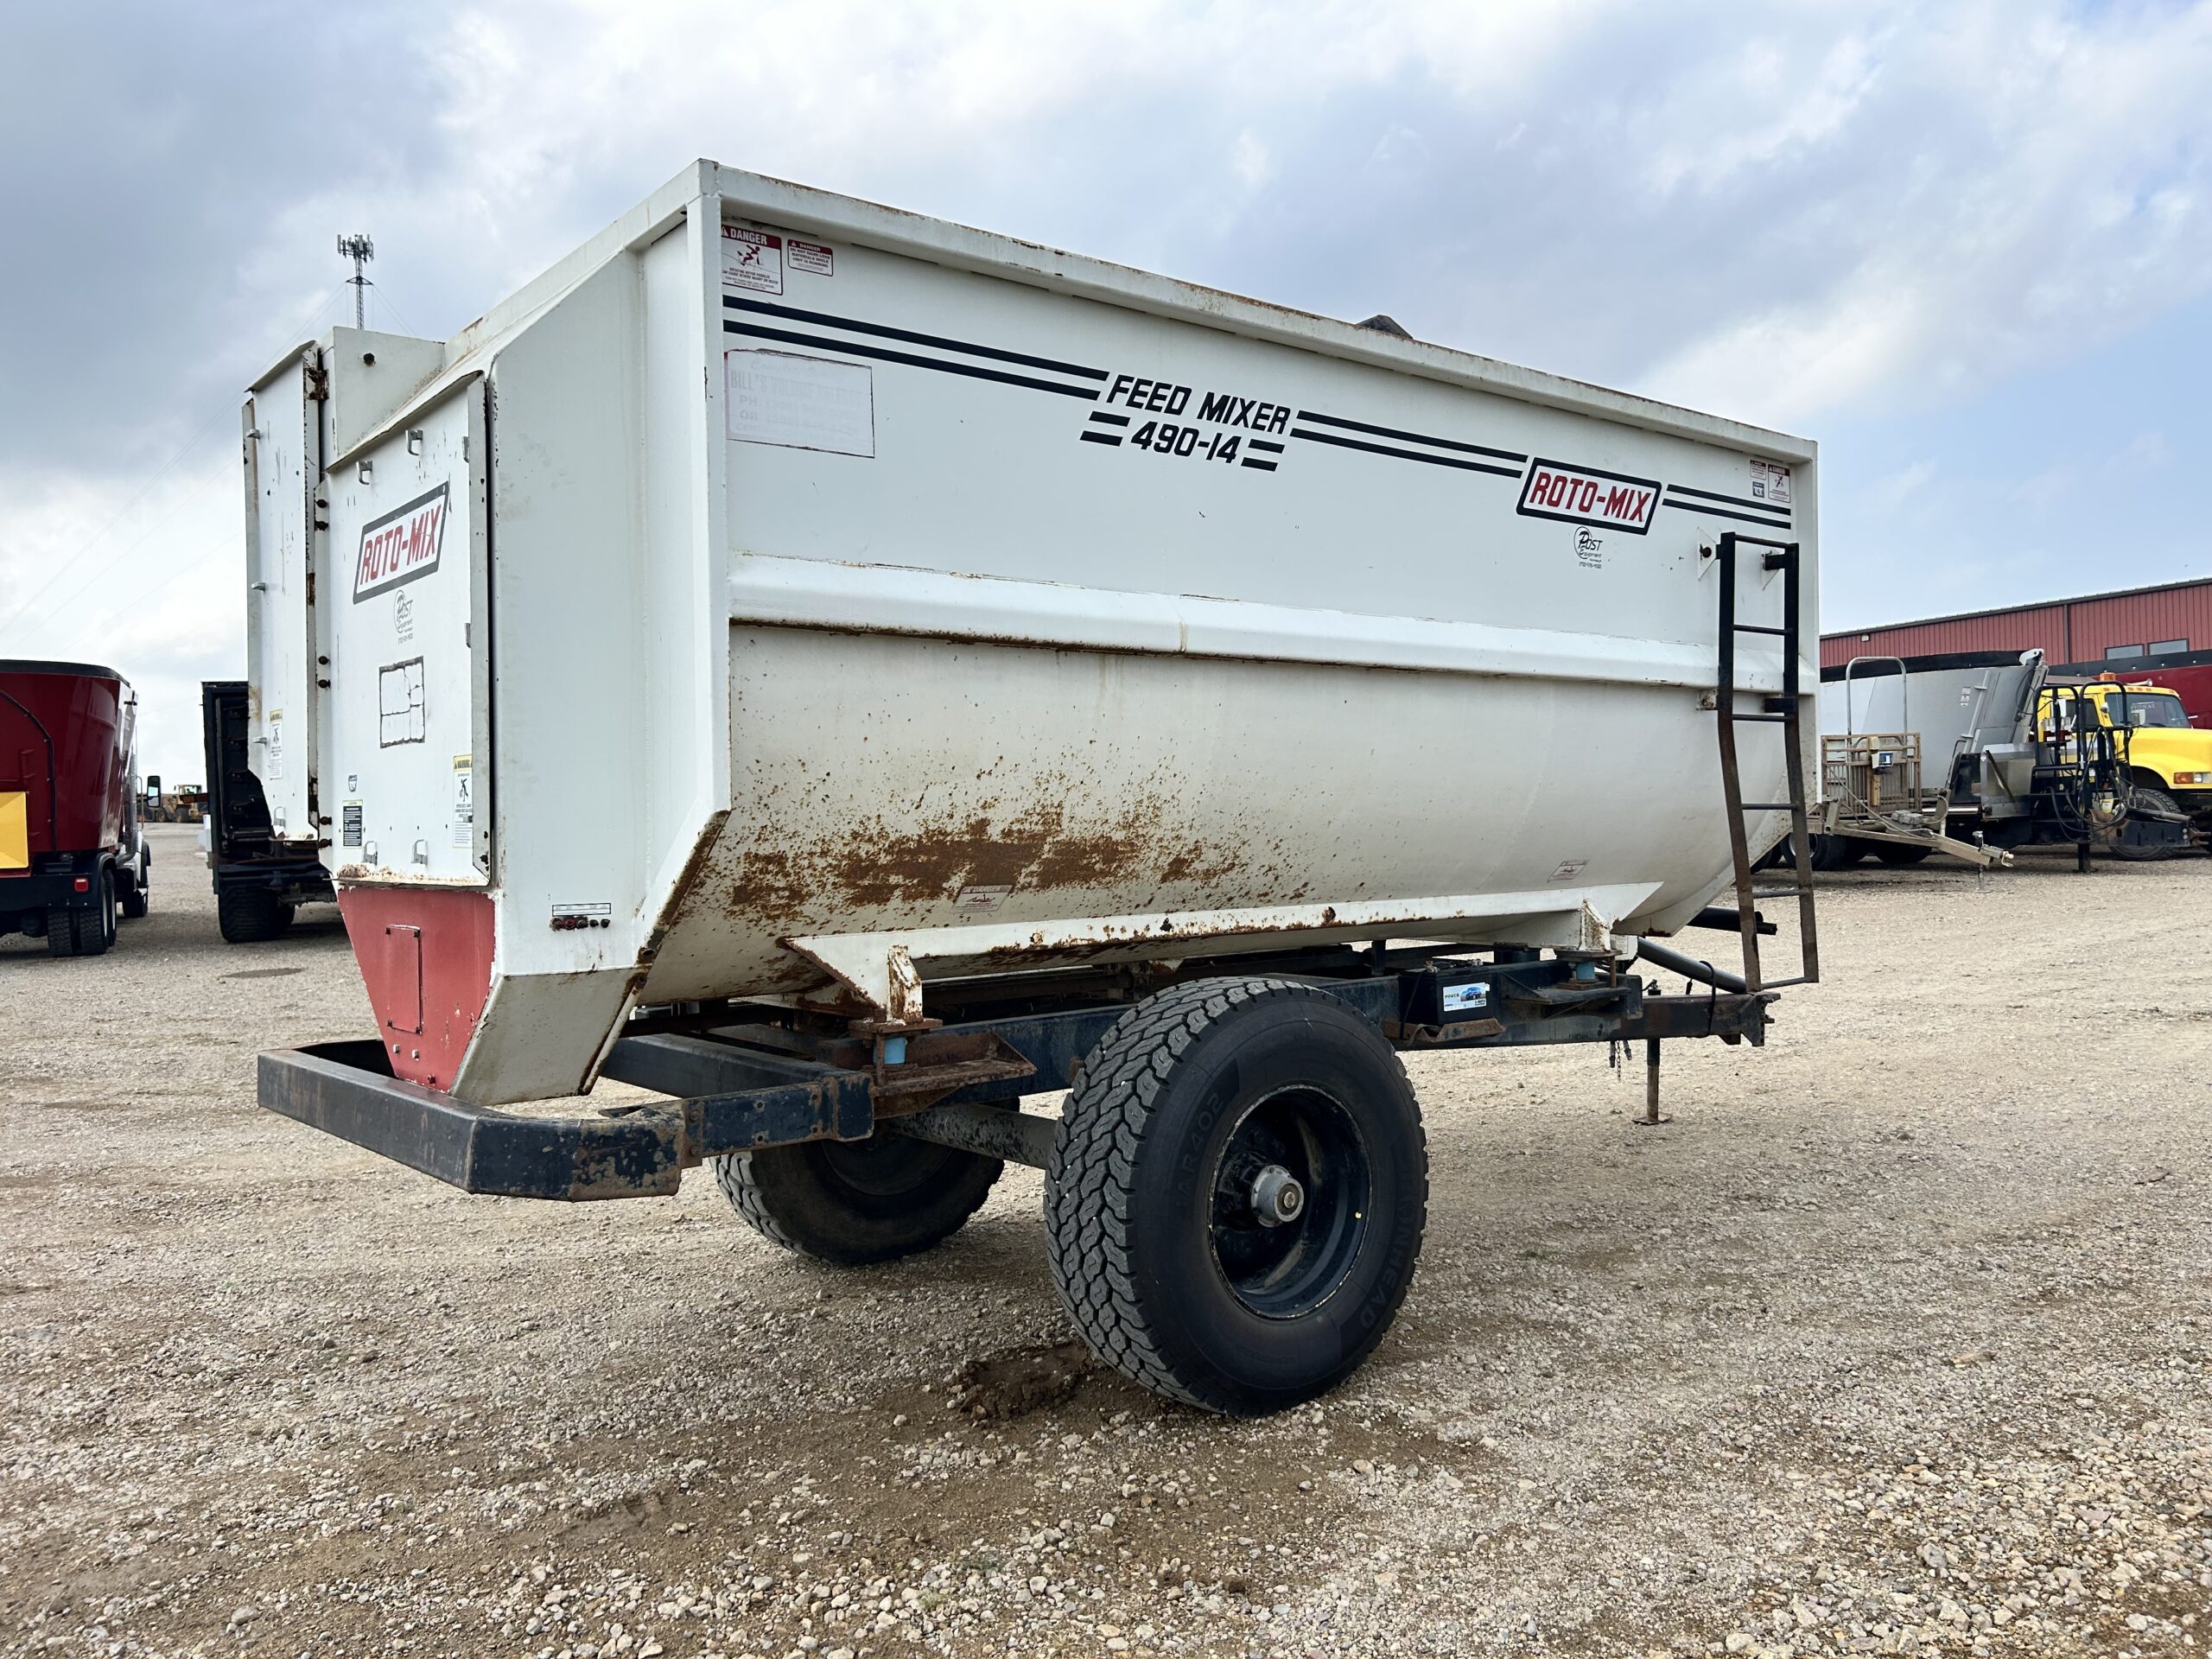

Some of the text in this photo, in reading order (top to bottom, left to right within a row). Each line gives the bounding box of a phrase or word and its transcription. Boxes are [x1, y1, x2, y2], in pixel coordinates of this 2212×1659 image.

[730, 228, 767, 245] DANGER
[799, 243, 821, 252] DANGER
[739, 410, 759, 422] OR
[1106, 374, 1291, 435] FEED MIXER
[1130, 421, 1242, 464] 490-14
[1529, 472, 1651, 522] ROTO-MIX
[359, 504, 442, 585] ROTO-MIX
[1176, 1093, 1224, 1209] IAR402
